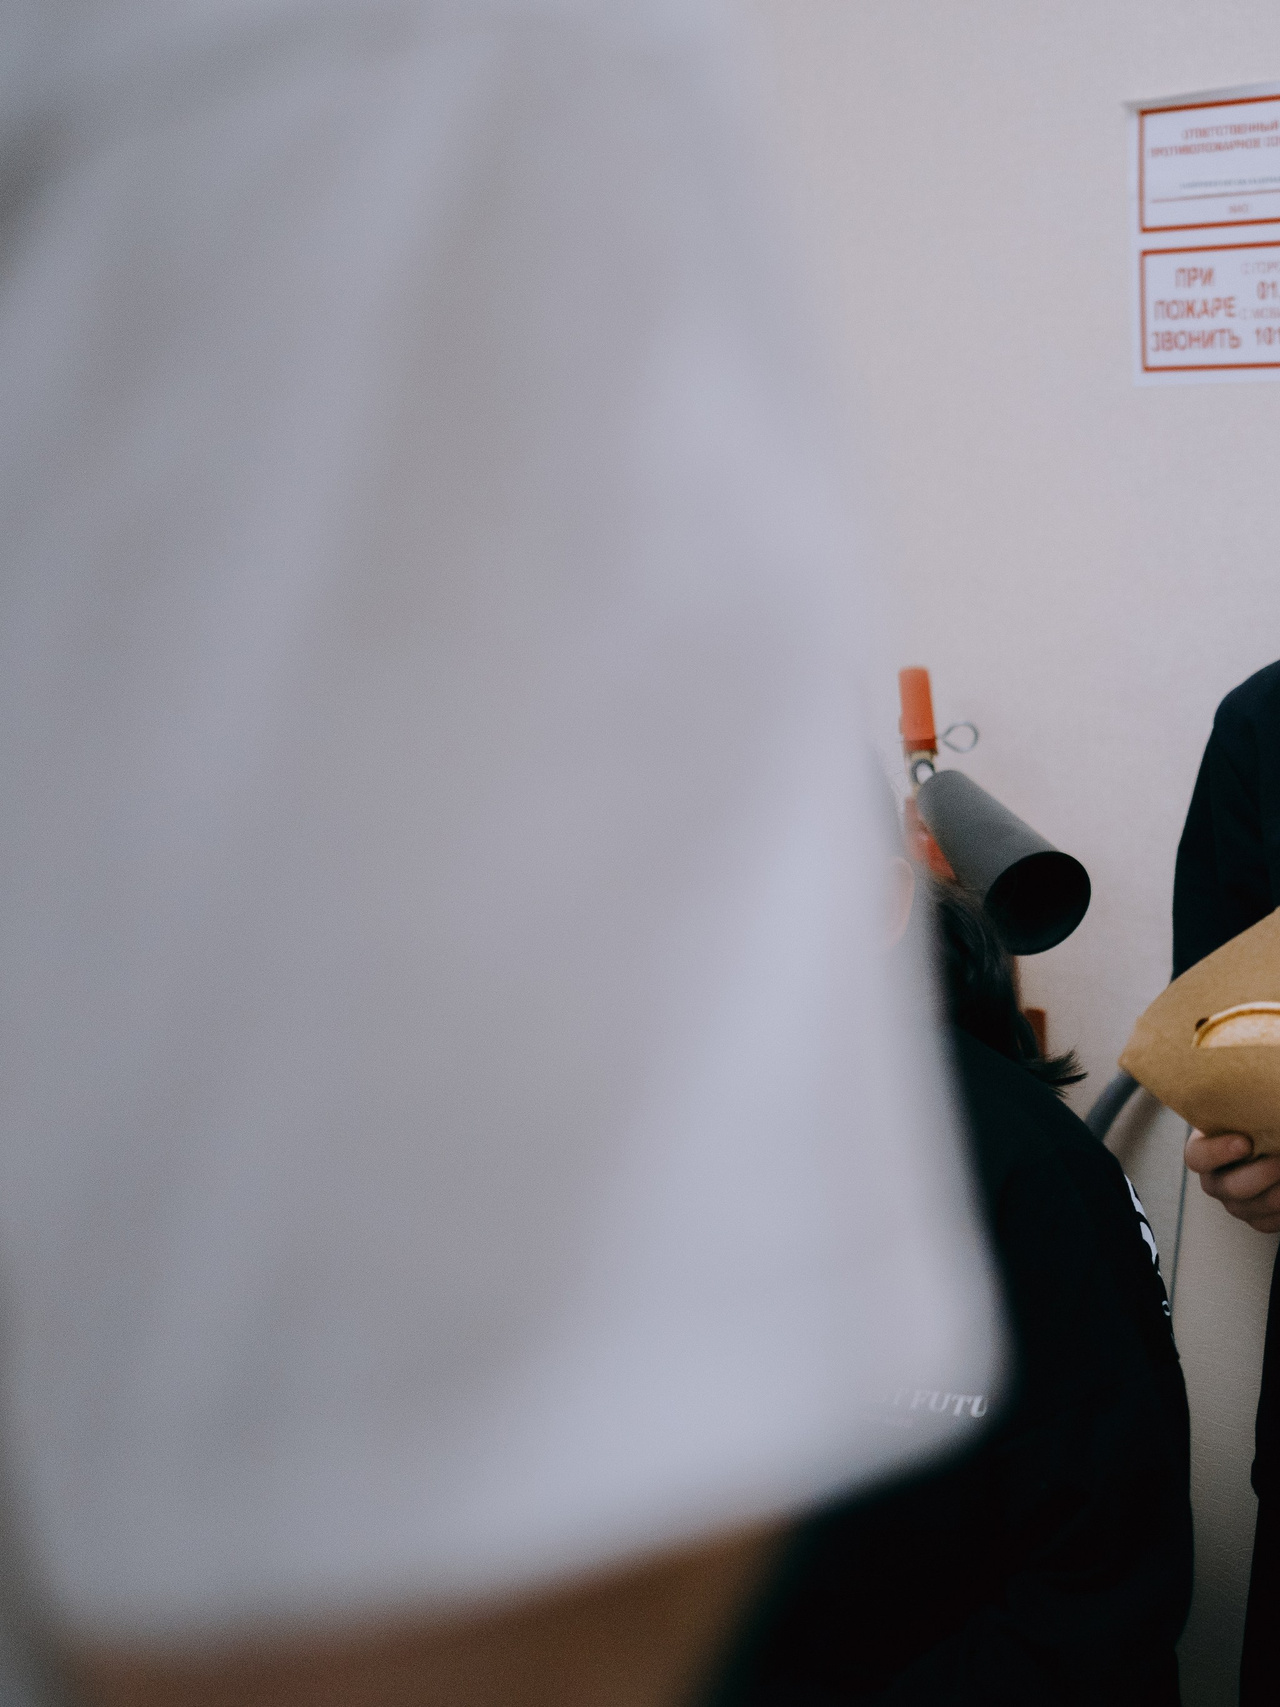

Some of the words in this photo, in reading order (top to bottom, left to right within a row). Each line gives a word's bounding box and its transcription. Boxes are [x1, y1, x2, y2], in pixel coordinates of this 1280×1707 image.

[1175, 267, 1215, 288] ПРИ
[1154, 296, 1236, 320] ПОЖАРЕ
[1152, 328, 1242, 351] ЗВОНИТЬ
